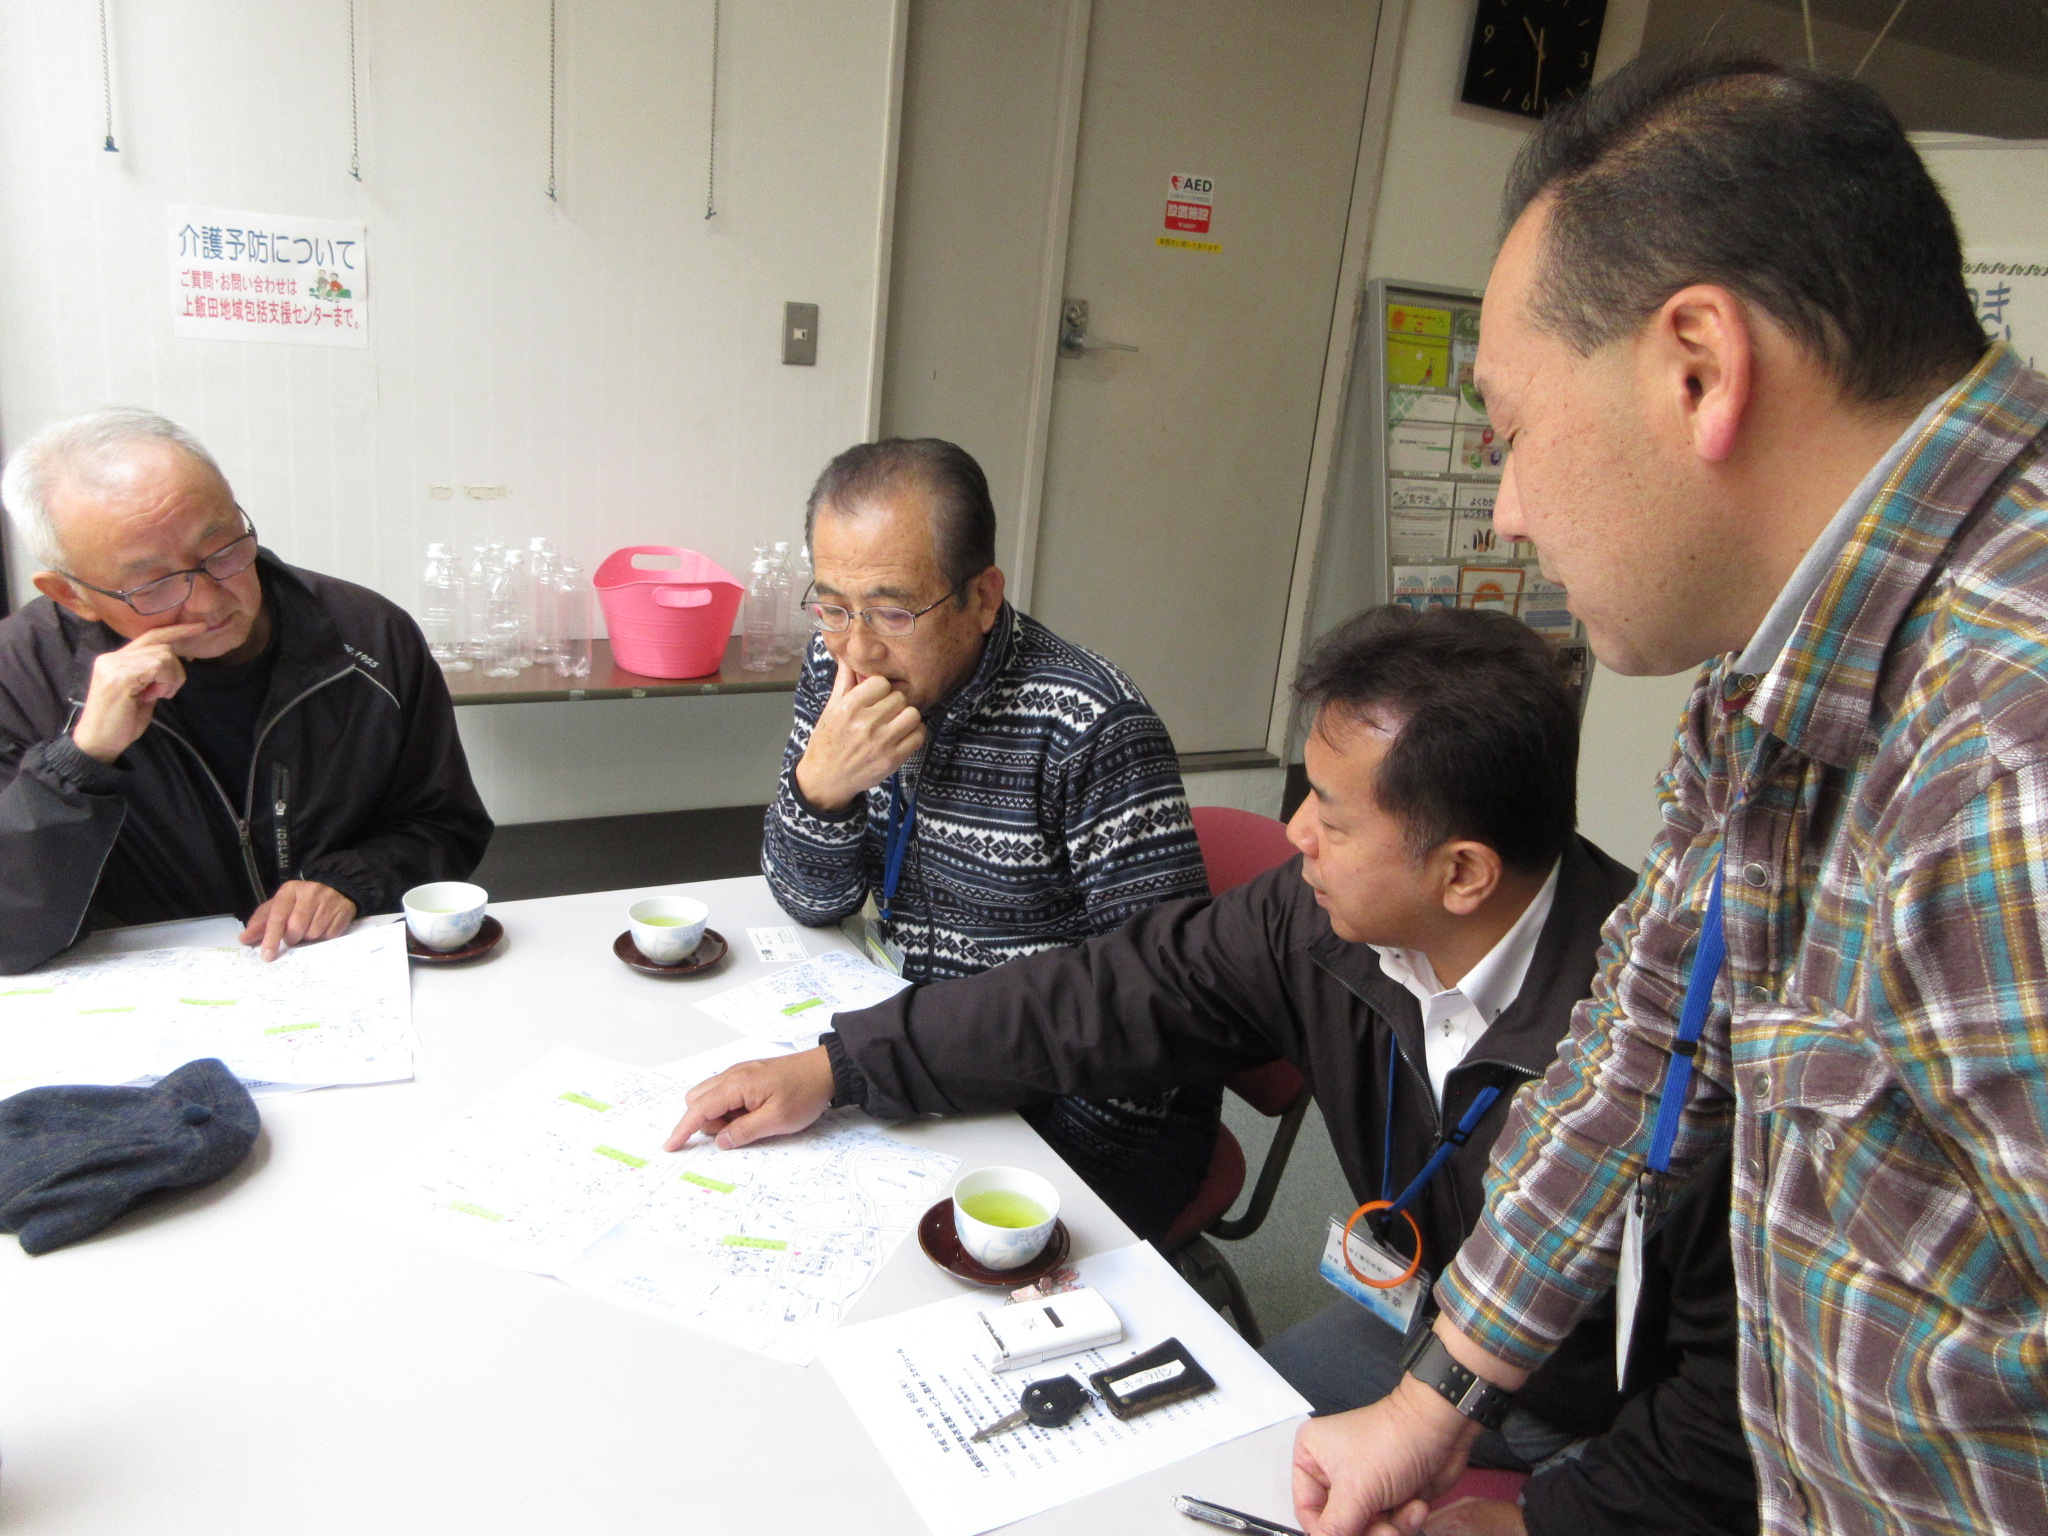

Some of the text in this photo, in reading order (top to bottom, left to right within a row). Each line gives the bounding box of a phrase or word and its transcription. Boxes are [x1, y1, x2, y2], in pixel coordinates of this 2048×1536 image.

[1485, 25, 1494, 43] 9
[1579, 51, 1589, 69] 3
[1521, 91, 1530, 111] 6
[1183, 177, 1213, 192] AED
[179, 224, 356, 269] 介護予防について
[181, 268, 298, 295] ご質問・お問い合わせは
[182, 294, 360, 330] 上飯田地域包括支援センターまで。
